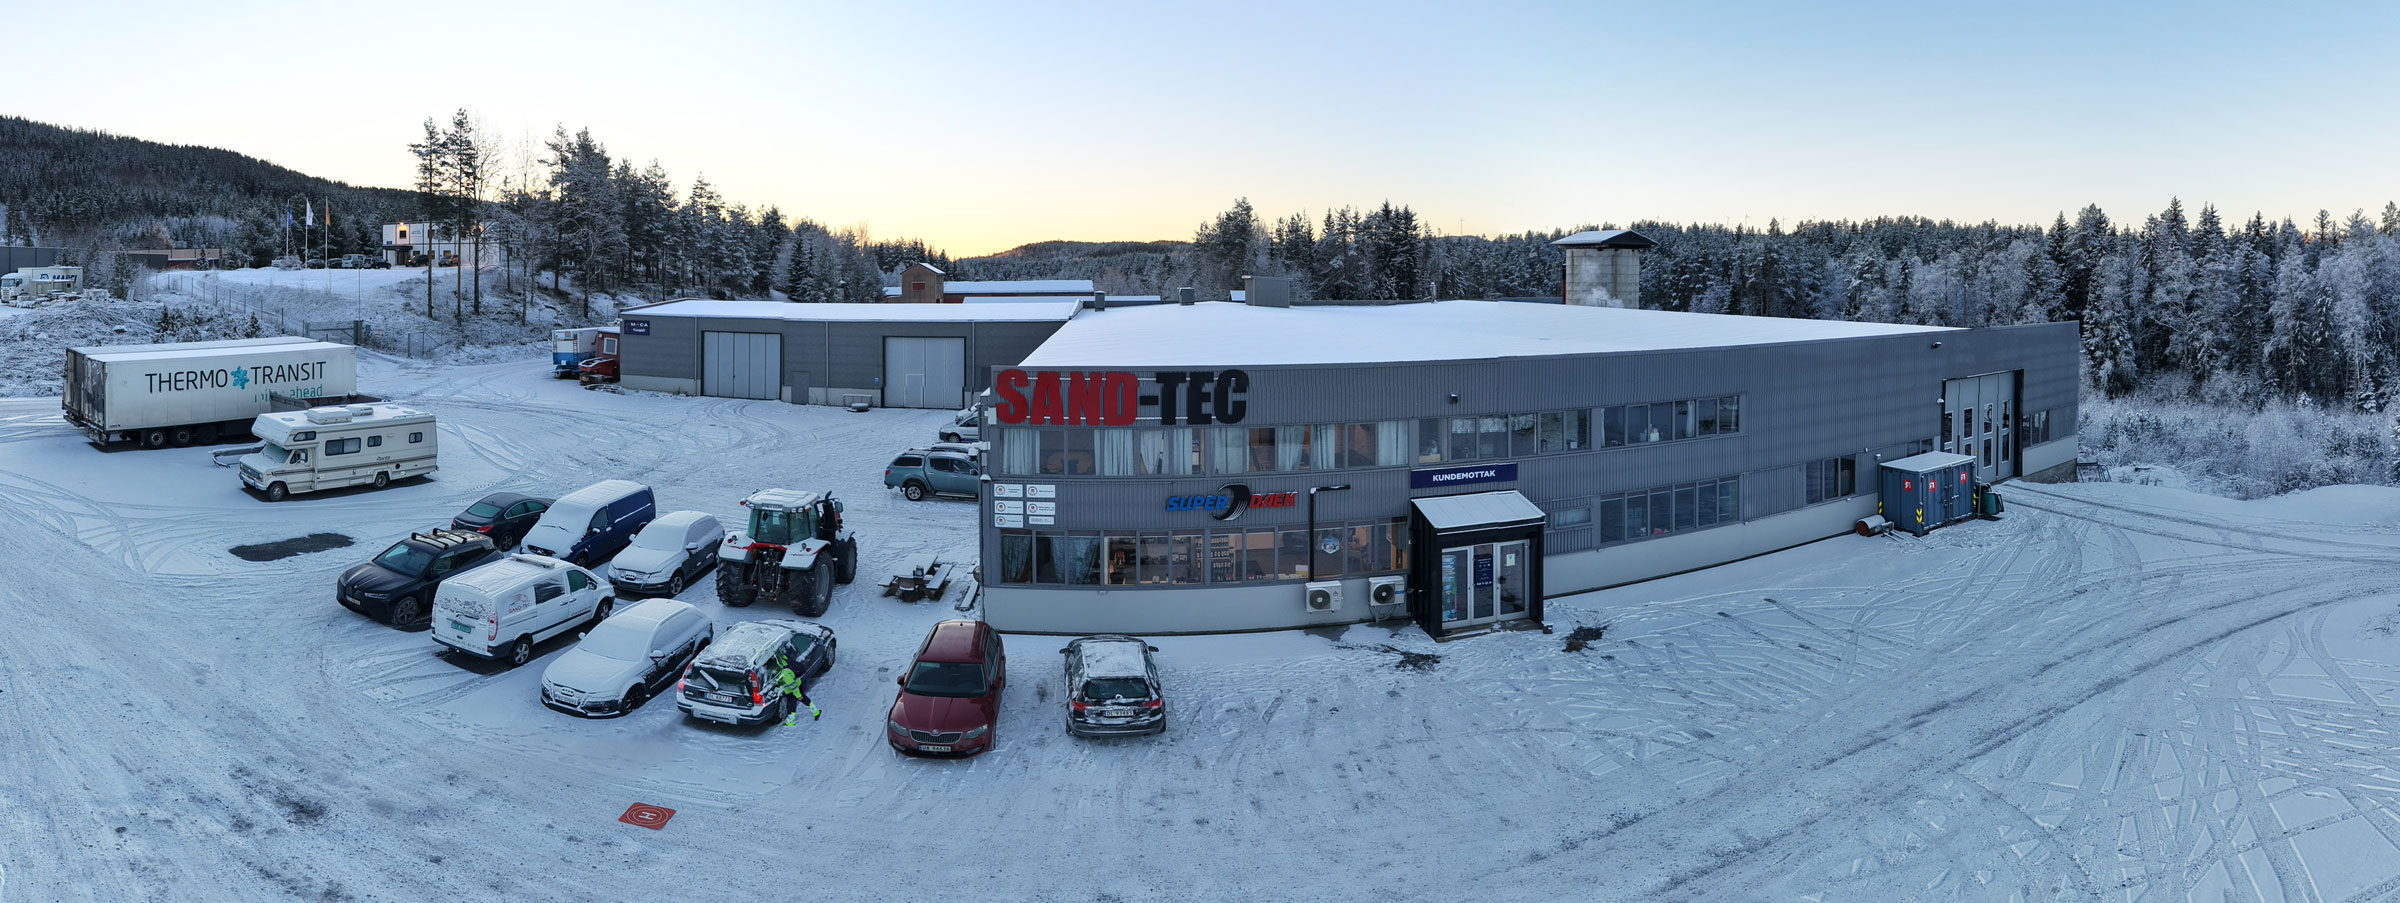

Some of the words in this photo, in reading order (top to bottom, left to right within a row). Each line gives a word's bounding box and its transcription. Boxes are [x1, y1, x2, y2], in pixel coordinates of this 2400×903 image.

[145, 369, 228, 394] THERMO
[251, 361, 327, 385] TRANSIT
[290, 384, 323, 399] ahead
[995, 369, 1250, 426] SAND-TEC
[1432, 470, 1496, 482] KUNDEMOTTAK
[1166, 495, 1229, 512] SUPER
